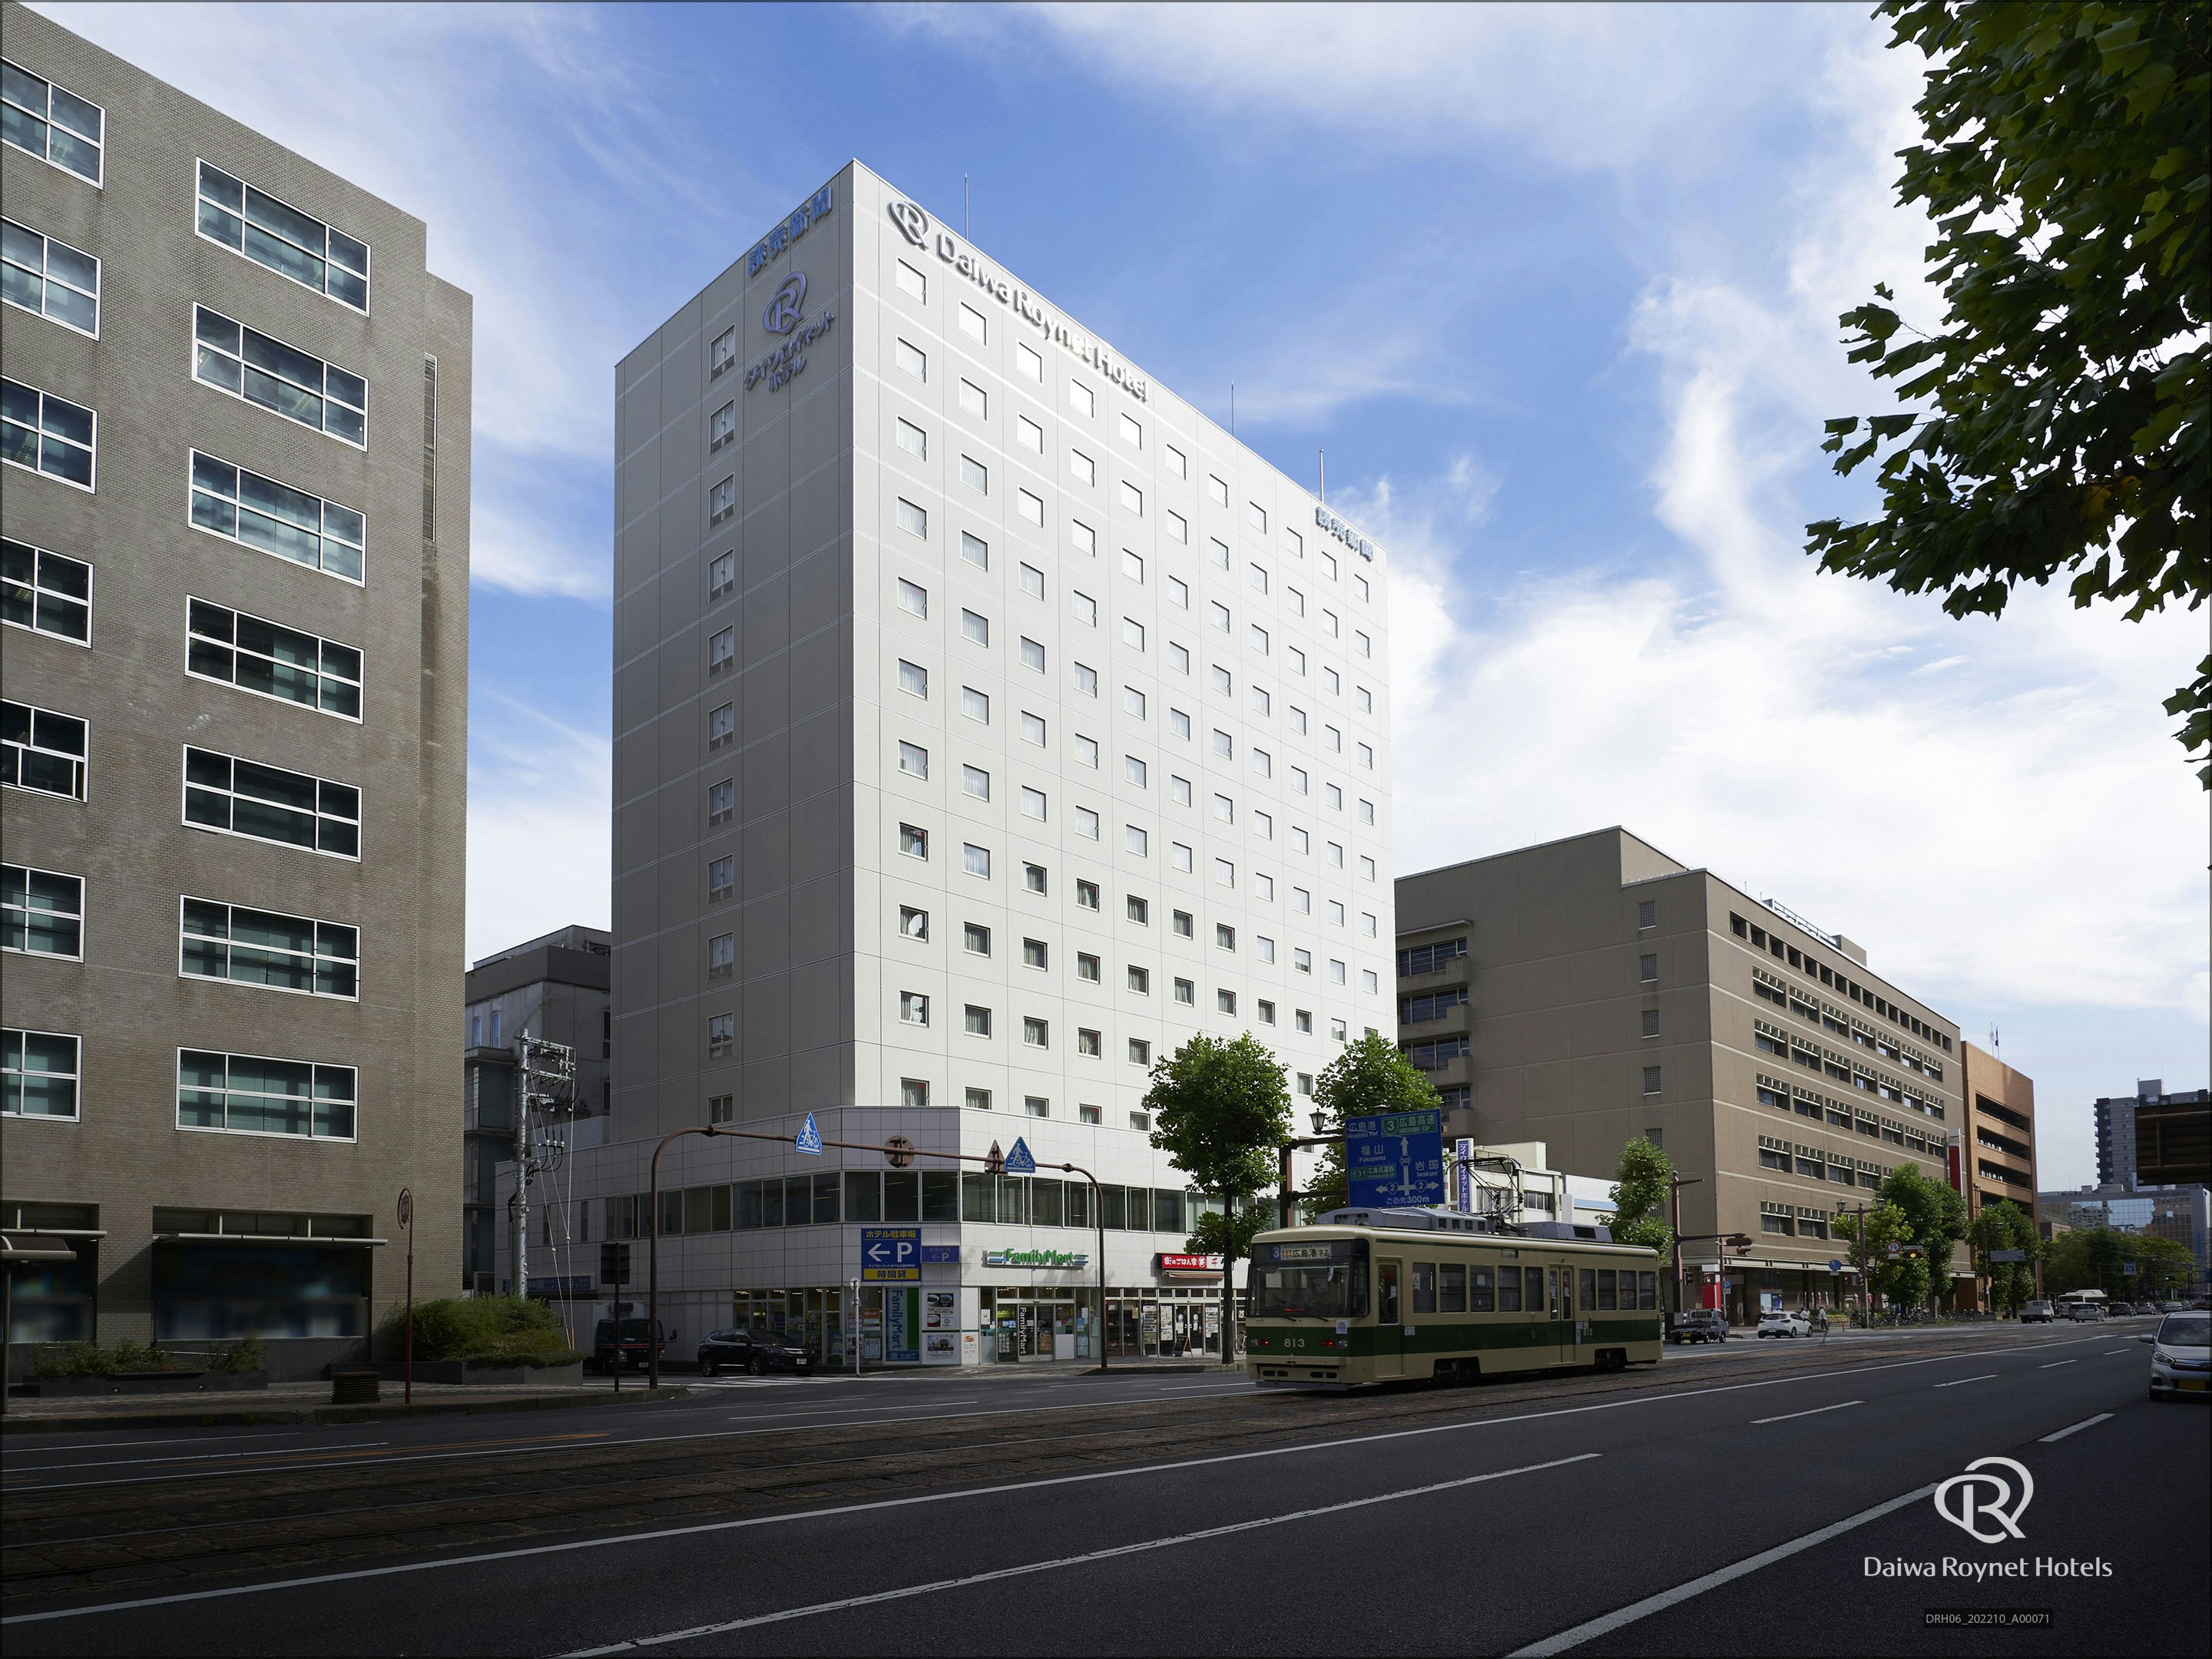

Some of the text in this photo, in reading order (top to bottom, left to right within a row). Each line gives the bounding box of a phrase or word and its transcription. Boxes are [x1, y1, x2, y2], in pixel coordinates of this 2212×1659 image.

[936, 230, 1150, 403] Daiwa Roynet Hotel
[743, 310, 836, 392] ダイワロイネット
[768, 354, 807, 393] ホテル
[1386, 1121, 1395, 1131] 3
[1399, 1114, 1435, 1127] 広島高速
[1349, 1121, 1377, 1132] 広島港
[1361, 1144, 1383, 1156] 福山
[1415, 1159, 1439, 1171] 岩国
[1353, 1169, 1366, 1177] E31
[1386, 1195, 1429, 1205] この先300m
[866, 1230, 916, 1239] ホテル駐車場
[897, 1242, 912, 1263] P
[942, 1253, 949, 1262] P
[1006, 1248, 1074, 1264] FamilyMart
[1273, 1247, 1280, 1258] 3
[1293, 1248, 1316, 1257] 広島港
[877, 1270, 906, 1278] 時間貸
[889, 1290, 903, 1349] FamilyMart
[1018, 1306, 1027, 1355] FamilyMart
[1283, 1338, 1306, 1348] 813
